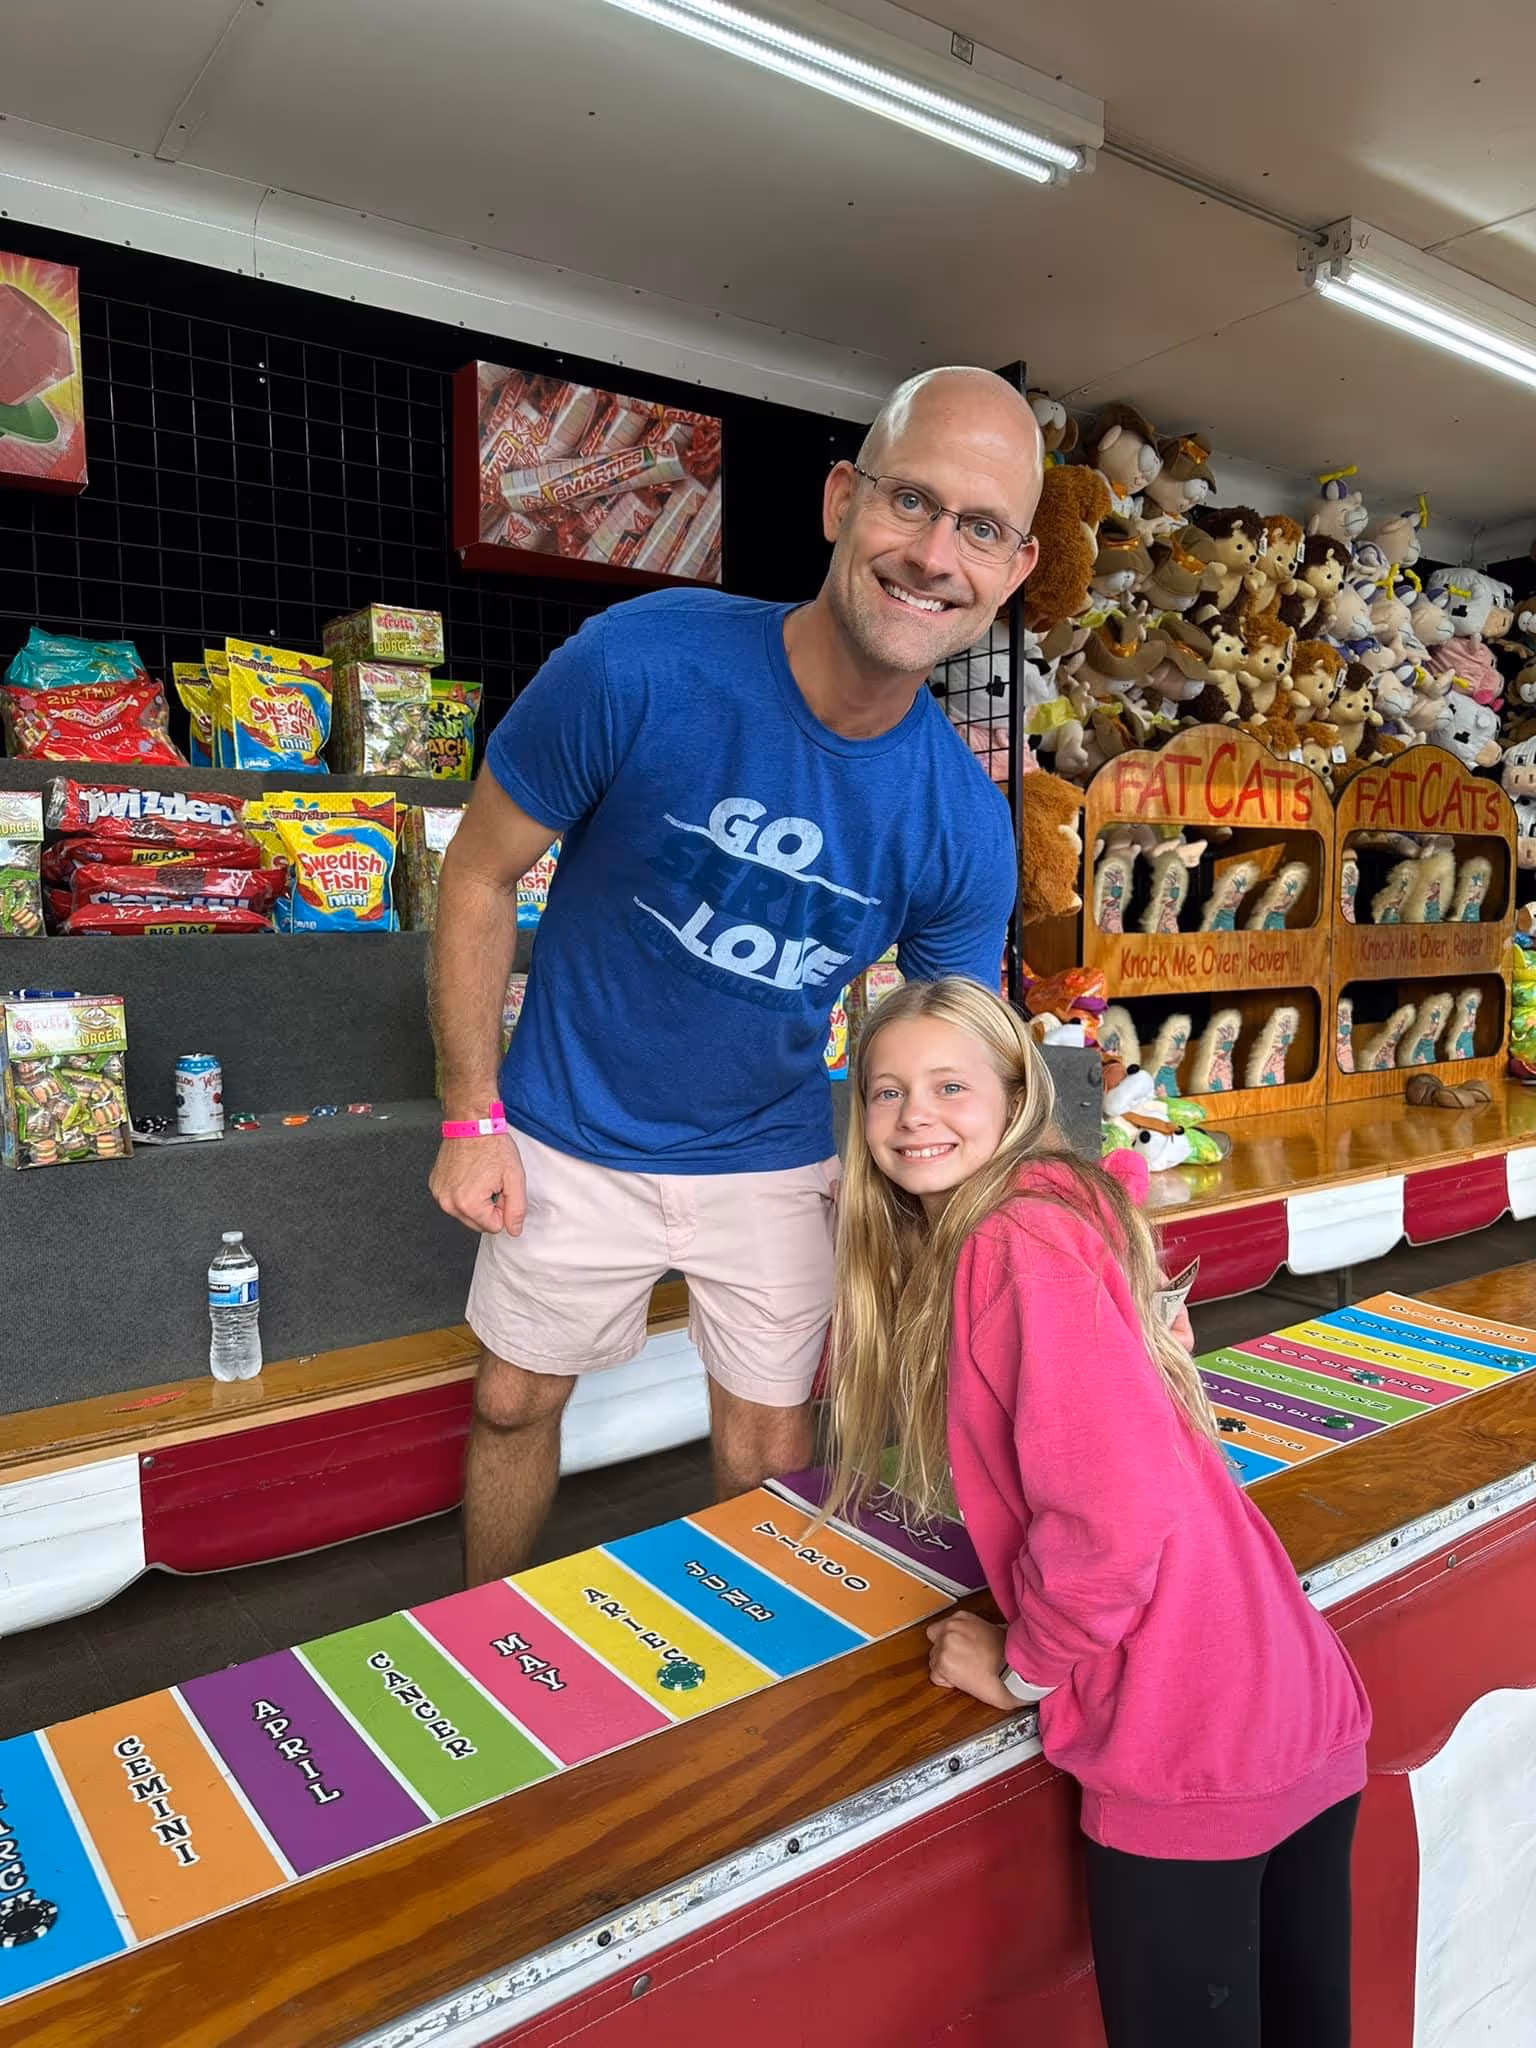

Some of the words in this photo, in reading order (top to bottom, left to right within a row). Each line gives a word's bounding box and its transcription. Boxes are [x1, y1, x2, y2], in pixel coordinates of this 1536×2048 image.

[552, 451, 643, 503] SMARTIES
[47, 695, 76, 705] 2lb
[250, 697, 316, 728] Swedish
[88, 722, 123, 741] iginal
[272, 716, 311, 739] Fish
[279, 736, 312, 751] mini
[429, 738, 466, 757] ATCH
[1114, 753, 1203, 816] FAT
[1204, 742, 1314, 822] CATS
[1355, 771, 1418, 825] FAT
[1419, 761, 1501, 832] CATS
[0, 819, 38, 834] URGER
[271, 809, 306, 822] Family
[307, 809, 330, 820] Size
[708, 797, 824, 874] GO
[136, 851, 160, 863] BIG
[297, 851, 383, 878] Swedish
[319, 871, 369, 893] Fish
[327, 894, 369, 908] mini
[521, 876, 548, 890] ish
[150, 926, 174, 936] BIG
[177, 924, 209, 935] BAG
[679, 901, 853, 987] LOVE
[1359, 935, 1395, 962] Knock
[1397, 933, 1417, 960] Me
[1420, 933, 1450, 960] Over,
[1454, 930, 1483, 958] Rover
[1119, 946, 1168, 980] Knock
[1171, 944, 1197, 977] Me
[1247, 943, 1289, 973] Rover
[74, 1028, 122, 1047] BURGER
[1389, 1304, 1529, 1344] PISCES
[1258, 1341, 1434, 1393] NOVEMER
[1302, 1327, 1472, 1378] AQUARIUS
[1203, 1381, 1324, 1422] CTOBE
[1215, 1356, 1392, 1411] CAPRICORN
[867, 1503, 953, 1551] ULY
[752, 1520, 870, 1593] VIRGO
[684, 1560, 775, 1623] JUNE
[581, 1585, 690, 1665] ARIES
[491, 1633, 567, 1692] MAY
[367, 1651, 477, 1761] CANCER
[253, 1699, 342, 1805] APRIL
[114, 1735, 200, 1867] GEMINI
